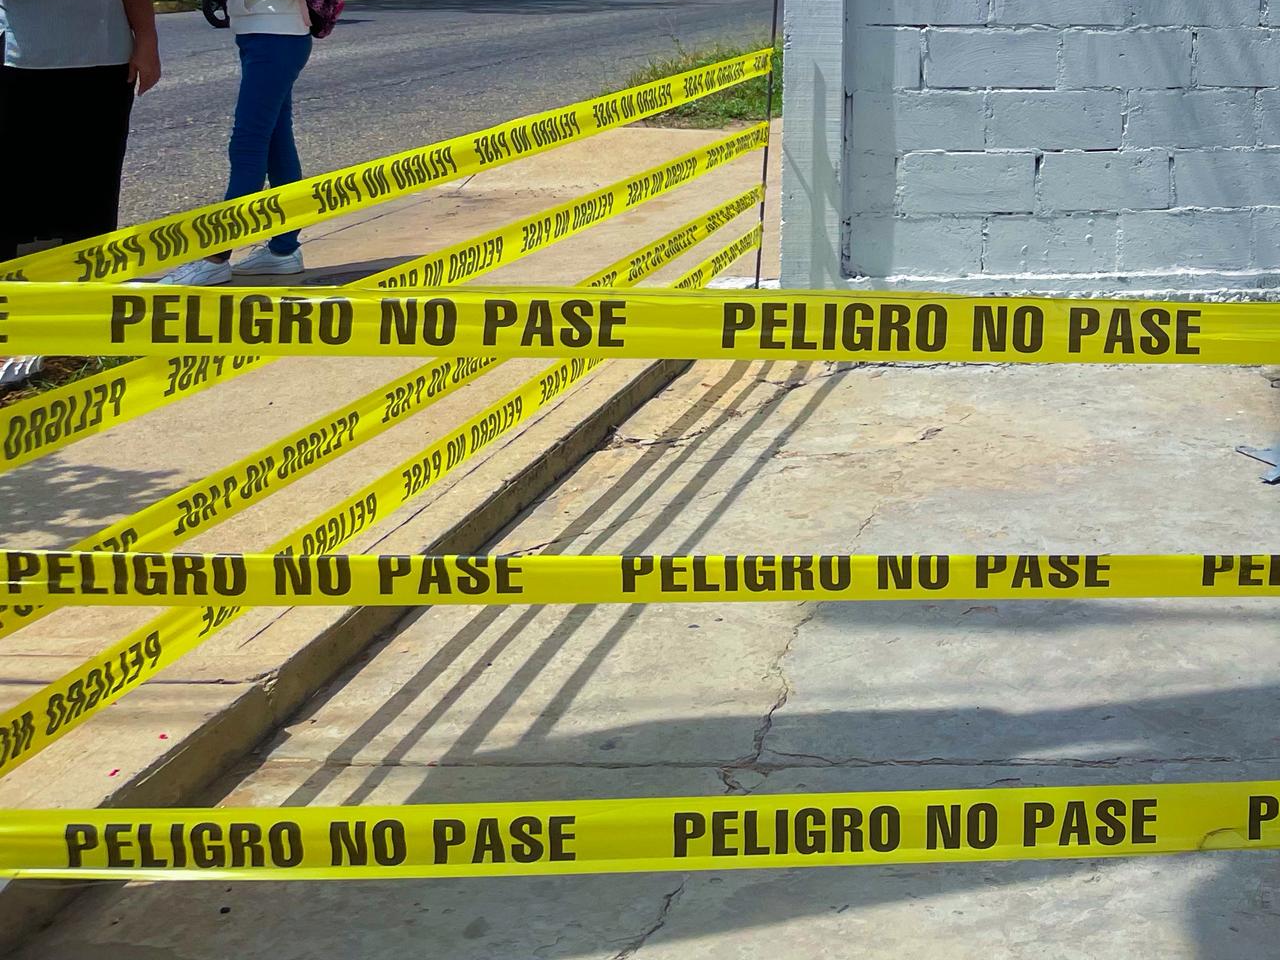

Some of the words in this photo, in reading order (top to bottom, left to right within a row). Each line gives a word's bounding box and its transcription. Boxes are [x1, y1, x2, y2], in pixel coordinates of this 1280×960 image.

[111, 295, 353, 345] PELIGRO
[379, 297, 457, 347] NO
[483, 299, 625, 348] PASE
[721, 302, 947, 353] PELIGRO
[972, 305, 1044, 354] NO
[1068, 306, 1201, 355] PASE
[7, 551, 247, 596] PELIGRO
[273, 555, 351, 596] NO
[378, 555, 523, 594] PASE
[621, 555, 851, 593] PELIGRO
[877, 555, 950, 591] NO
[975, 555, 1110, 589] PASE
[63, 821, 304, 869] PELIGRO
[329, 819, 407, 867] NO
[431, 815, 577, 865] PASE
[672, 805, 901, 858] PELIGRO
[925, 802, 999, 852] NO
[1022, 798, 1158, 849] PASE
